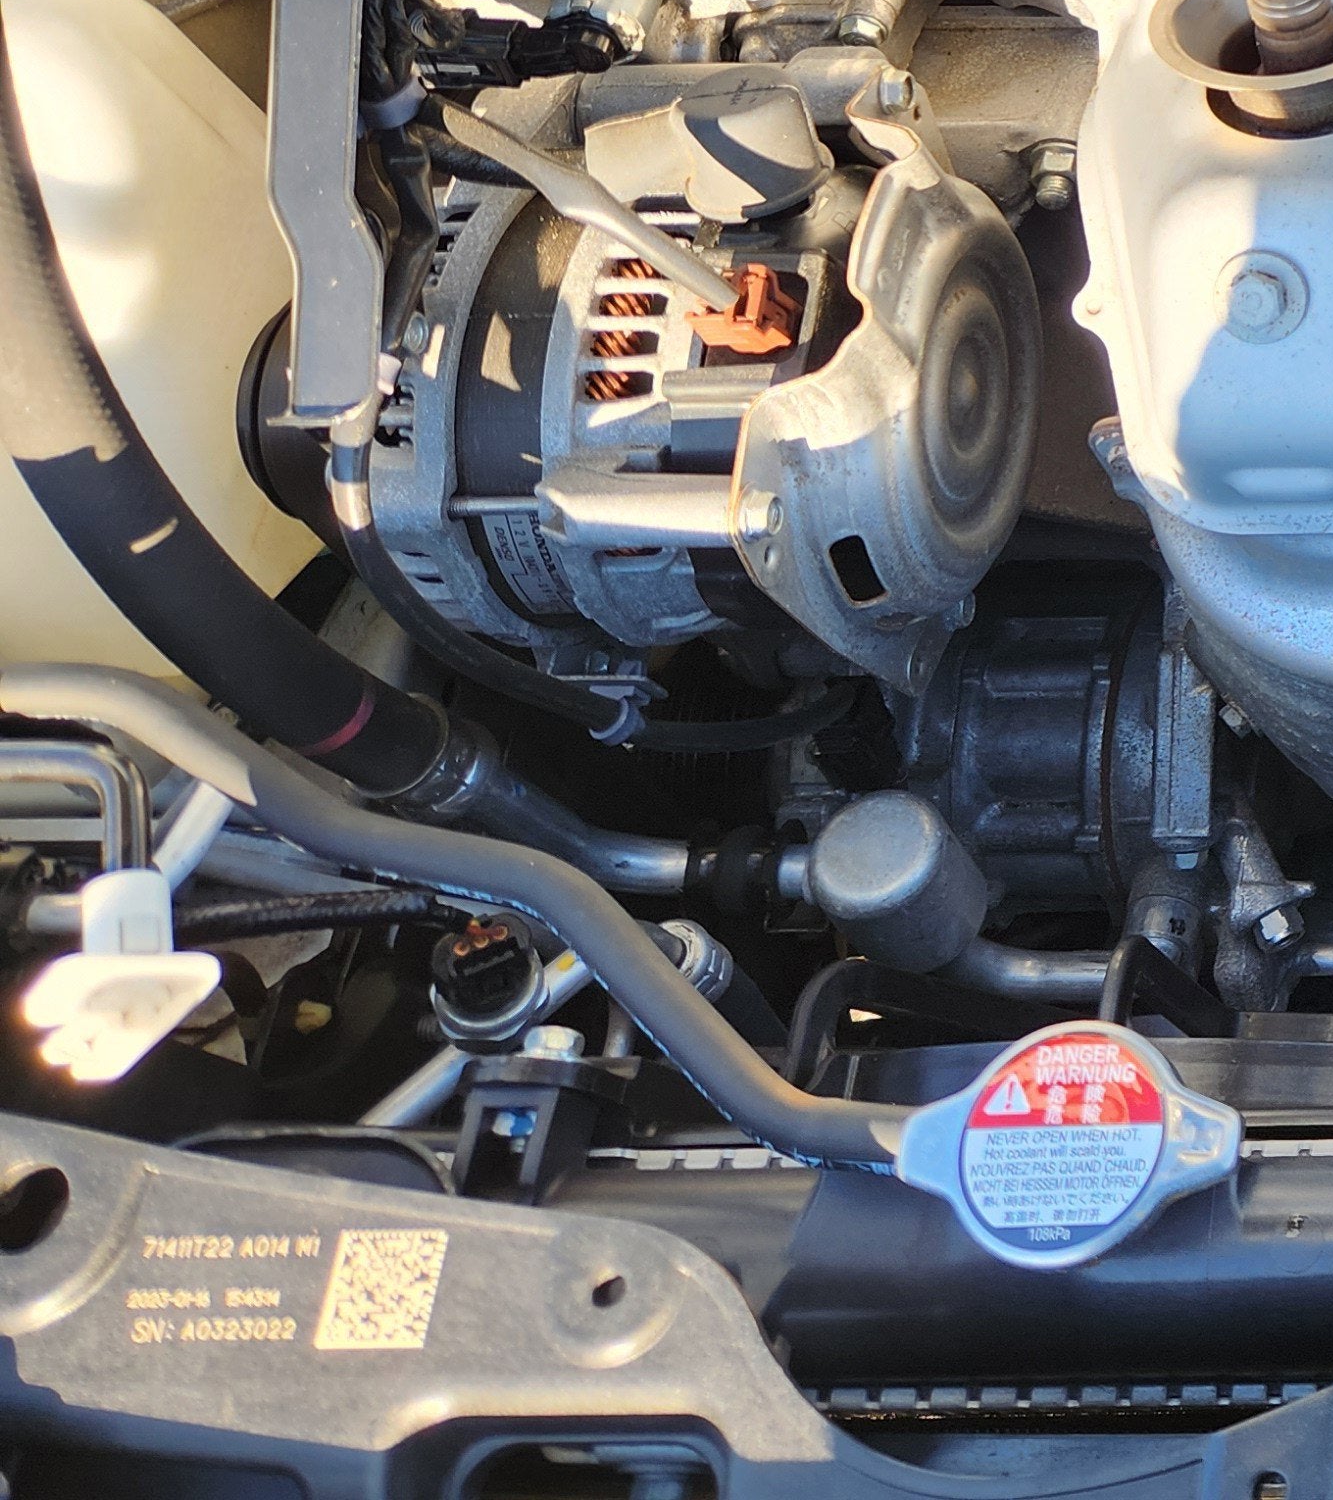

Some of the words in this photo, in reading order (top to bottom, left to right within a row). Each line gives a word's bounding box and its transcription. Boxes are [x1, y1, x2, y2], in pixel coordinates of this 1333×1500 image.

[494, 526, 515, 561] DENSO
[1037, 1044, 1121, 1065] DANGER
[1035, 1063, 1137, 1085] WARNUNG
[987, 1132, 1029, 1146] NEVER
[1032, 1131, 1069, 1144] OPEN
[1071, 1129, 1109, 1143] WHEN
[1112, 1127, 1142, 1141] HOT.
[984, 1148, 1004, 1160] Hot
[1006, 1146, 1047, 1159] coolant
[1050, 1145, 1067, 1157] will
[1070, 1145, 1100, 1157] scald
[970, 1162, 1030, 1177] N'OUVREZ
[1032, 1162, 1056, 1175] PAS
[1058, 1160, 1100, 1174] QUAND
[1104, 1158, 1149, 1172] CHAUD.
[972, 1179, 1002, 1193] NICHT
[1004, 1179, 1019, 1192] BEI
[1021, 1177, 1063, 1192] HEISSEM
[1065, 1176, 1100, 1190] MOTOR
[1028, 1227, 1071, 1242] 108kPa
[142, 1235, 235, 1260] 71411T22
[239, 1235, 290, 1259] A014
[131, 1317, 175, 1344] SN:
[180, 1316, 297, 1343] A0323022
